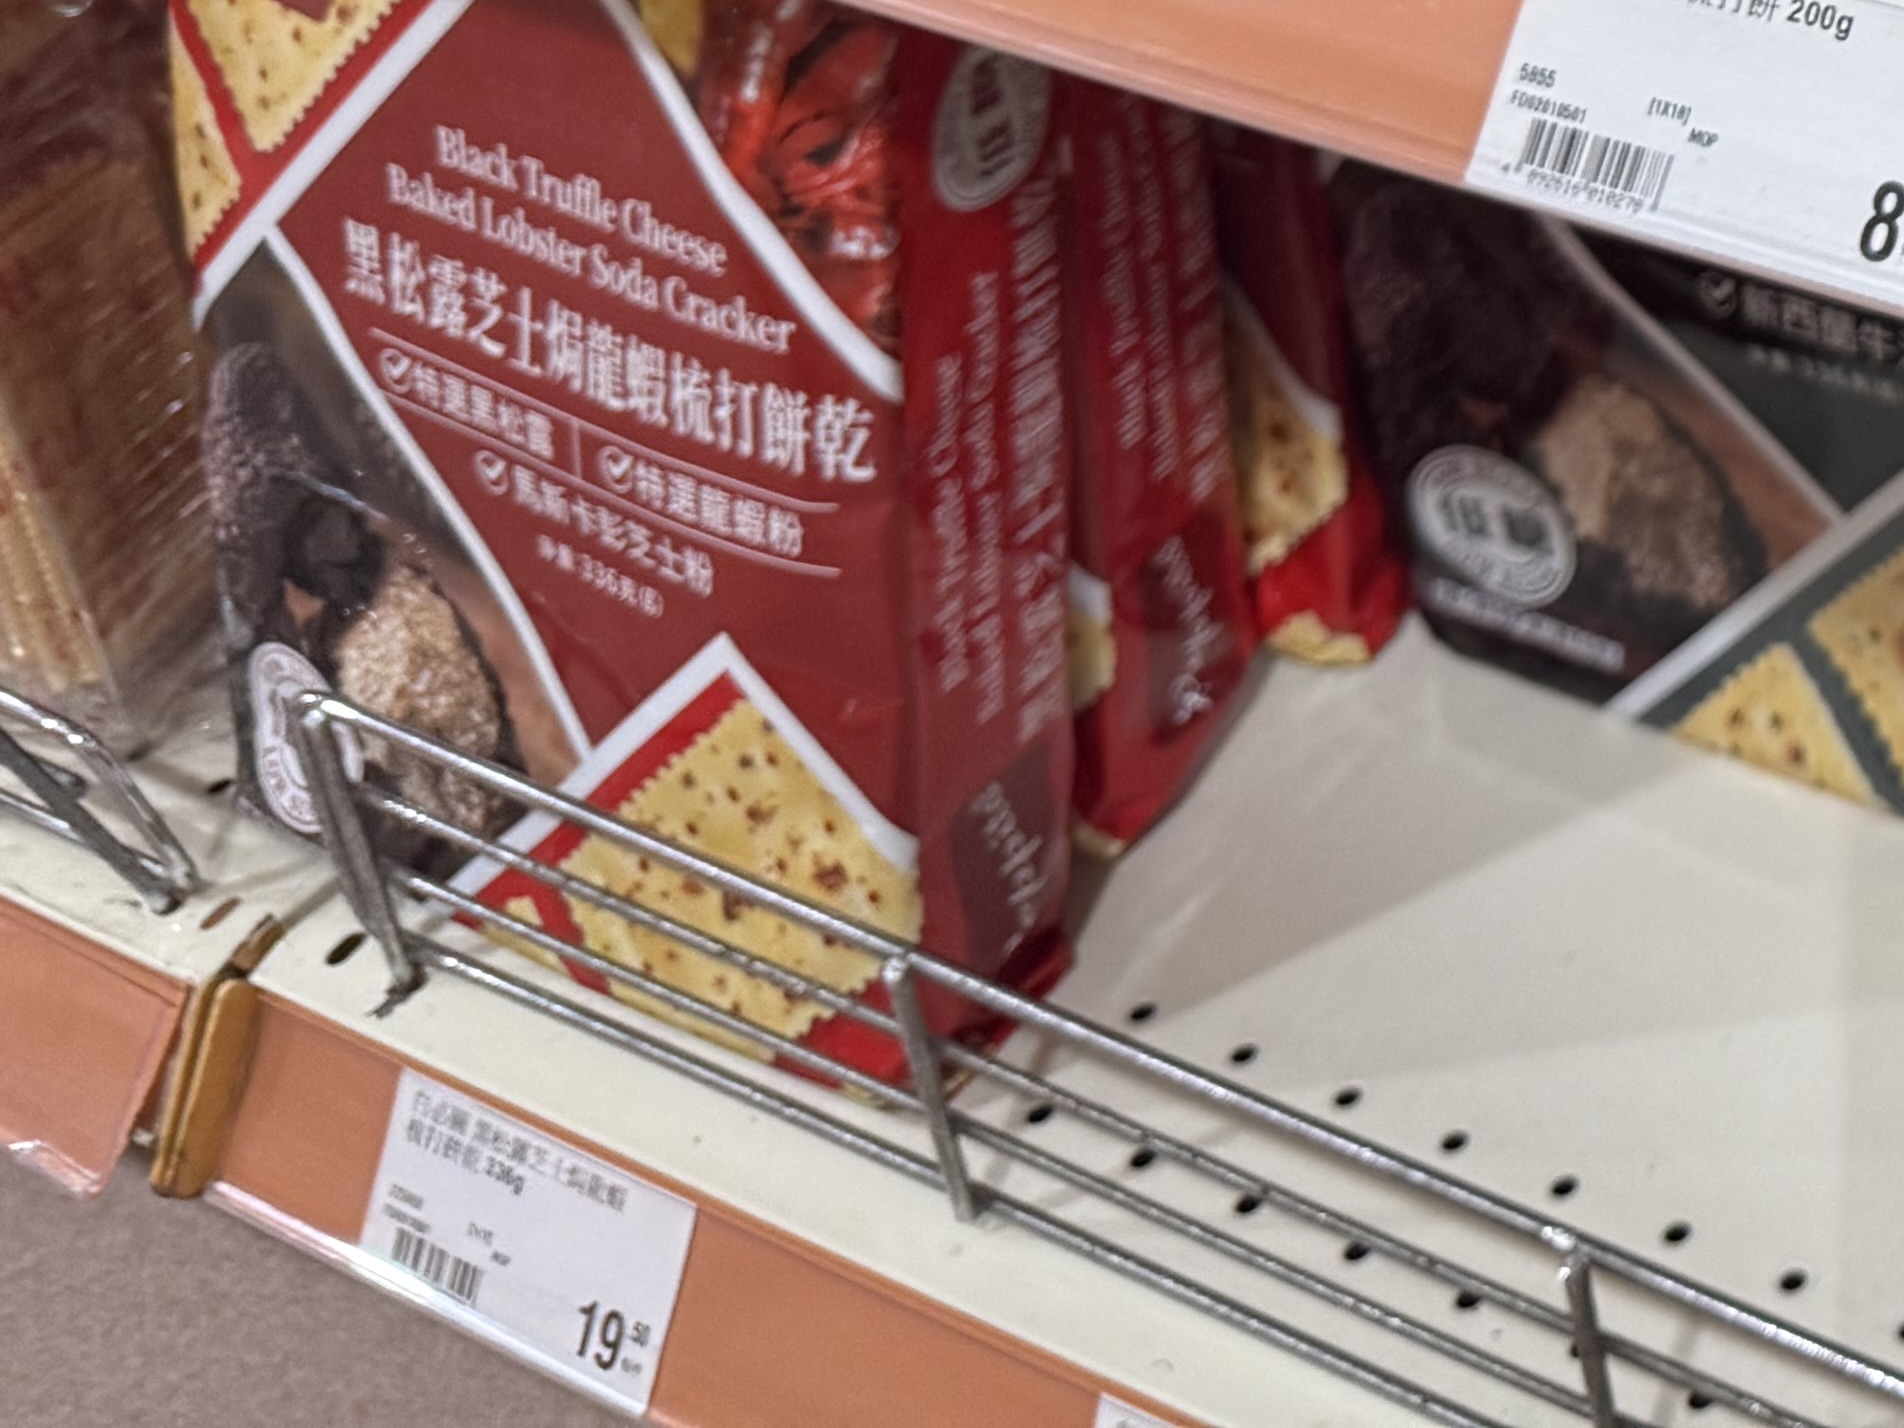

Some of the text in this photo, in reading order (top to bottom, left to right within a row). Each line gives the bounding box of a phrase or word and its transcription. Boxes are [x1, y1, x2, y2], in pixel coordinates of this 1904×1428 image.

[1518, 61, 1558, 88] 5855
[1687, 126, 1720, 149] MOP
[435, 124, 729, 276] Black Truffle Cheese
[386, 162, 797, 356] Baked Lobster Soda Cracker
[575, 1298, 627, 1372] 19
